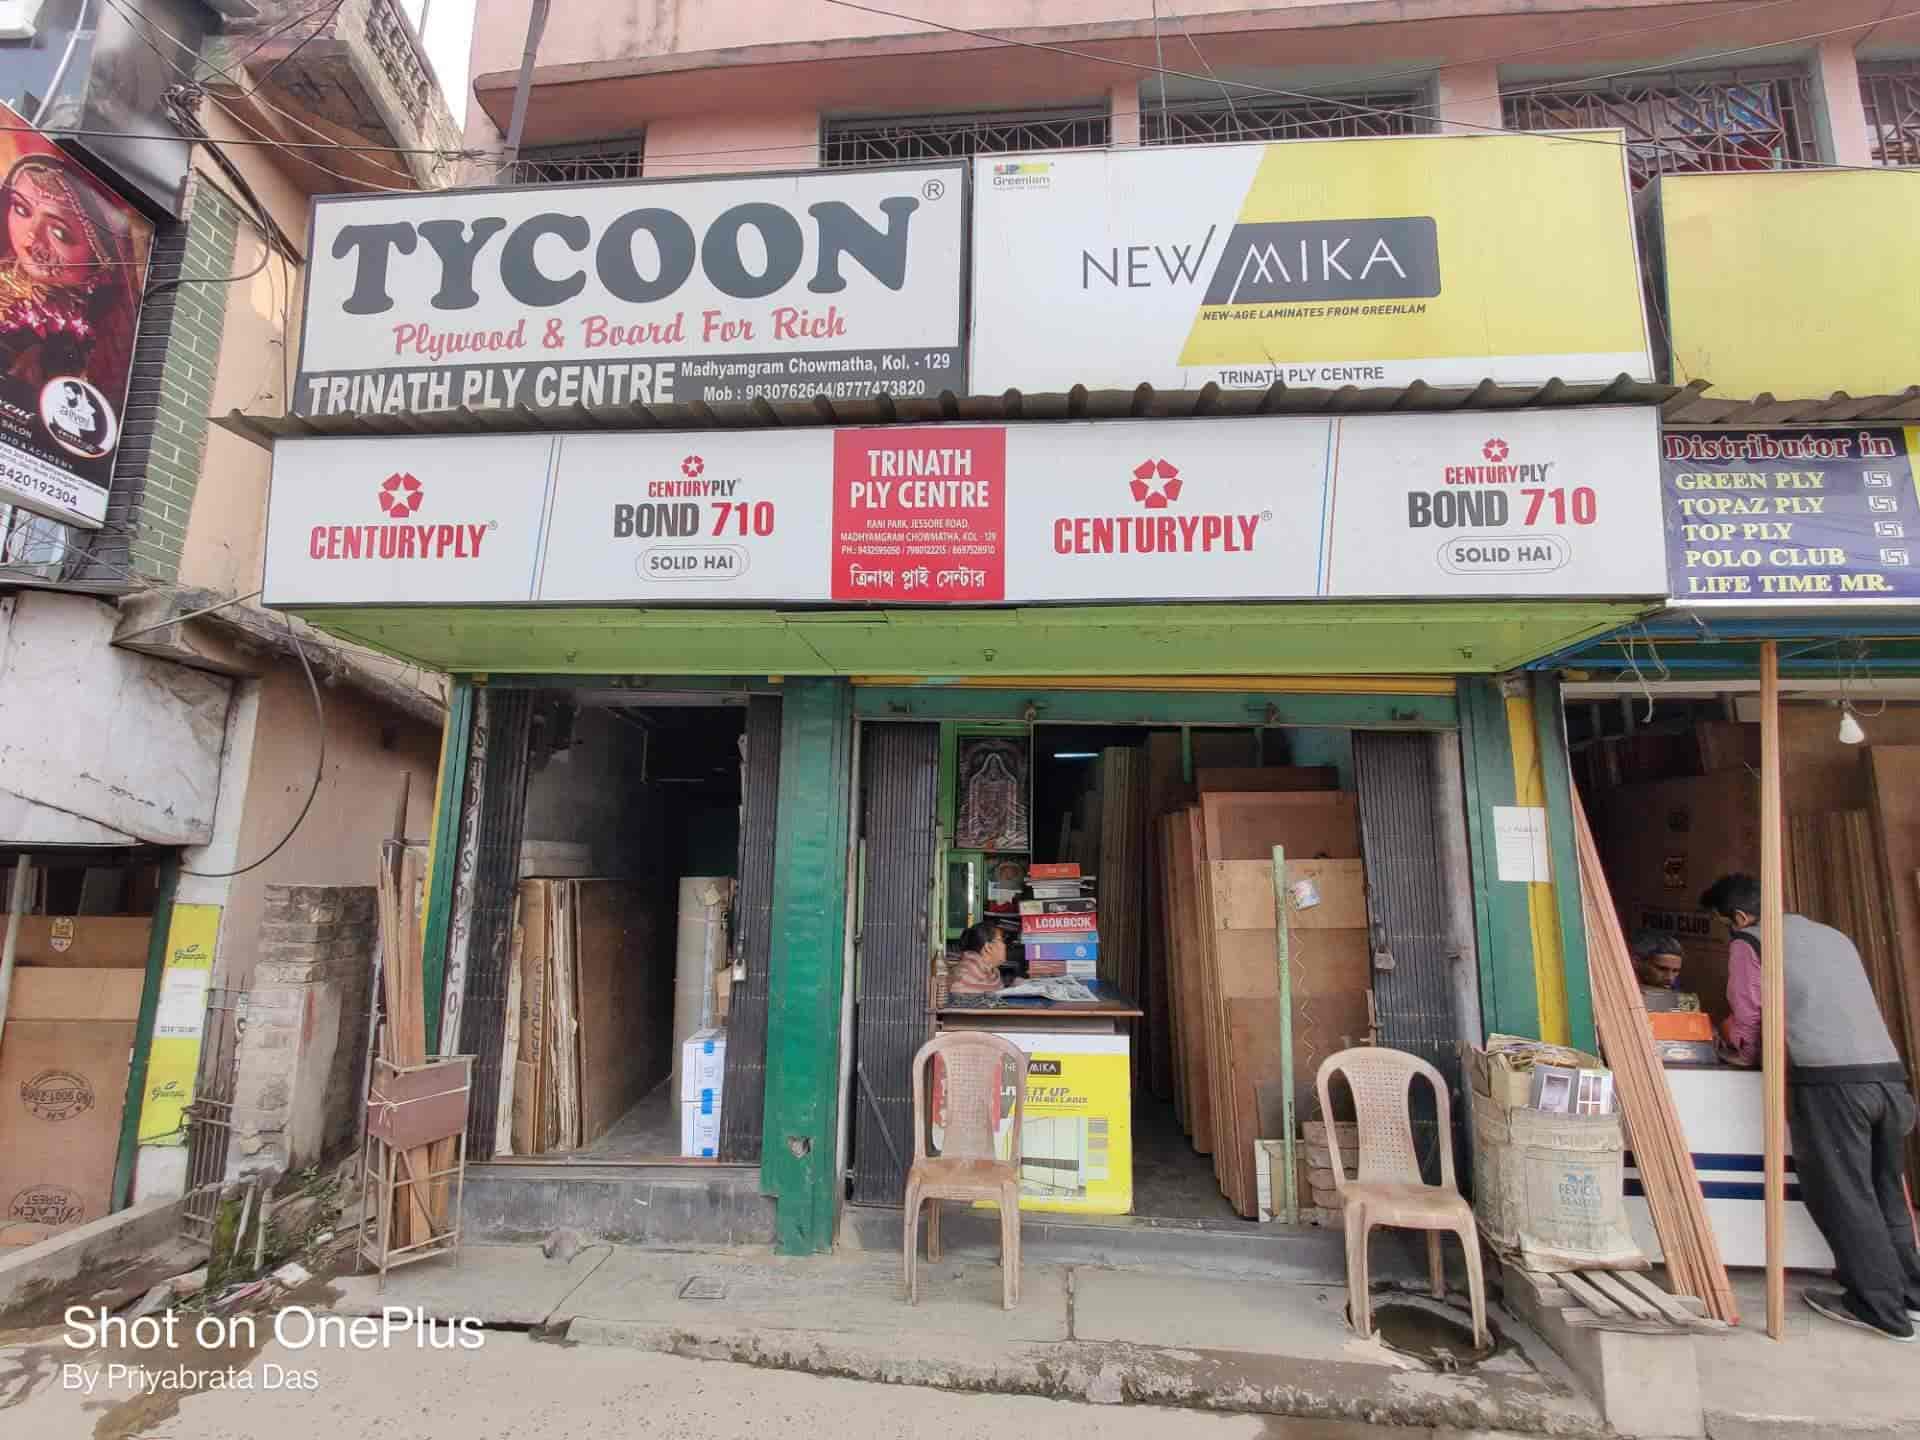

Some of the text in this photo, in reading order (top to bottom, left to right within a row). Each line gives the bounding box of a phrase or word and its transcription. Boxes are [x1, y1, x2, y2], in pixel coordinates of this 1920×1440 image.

[331, 196, 920, 315] TYCOON
[1082, 224, 1407, 304] NEW MIKA
[1202, 303, 1426, 321] NEW-AGE LAMINATES FROM GREENLAM
[393, 305, 847, 361] Plywood & Board For Rich
[681, 361, 784, 379] Madhyamgram
[788, 355, 877, 374] Chowmatha,
[882, 354, 910, 370] Kol.
[924, 352, 951, 369] 129
[1219, 366, 1384, 384] TRINATH PLY CENTRE
[308, 362, 676, 416] TRINATH PLY CENTRE
[704, 385, 733, 401] Mob
[1664, 432, 1896, 460] Distributor in
[867, 448, 972, 477] TRINATH
[1445, 464, 1548, 485] CENTURYPLY
[1675, 471, 1825, 490] GREEN PLY
[648, 479, 736, 497] CENTURYPLY
[850, 480, 989, 508] PLY CENTRE
[1407, 486, 1597, 529] BOND 710
[1678, 496, 1825, 516] TOPAZ PLY
[613, 500, 775, 538] BOND 710
[310, 523, 488, 559] CENTURYPLY
[1053, 514, 1259, 555] CENTURYPLY
[1681, 522, 1793, 542] TOP PLY
[650, 554, 734, 570] SOLID HAI
[1454, 545, 1553, 563] SOLID HAI
[1685, 547, 1848, 568] POLO CLUB
[850, 563, 987, 589] ত্রিনাথ প্লাই সেন্টার
[1687, 573, 1895, 593] LIFE TIME MR.
[1035, 917, 1092, 929] LOOKBOOK
[1028, 1063, 1057, 1074] MIKA
